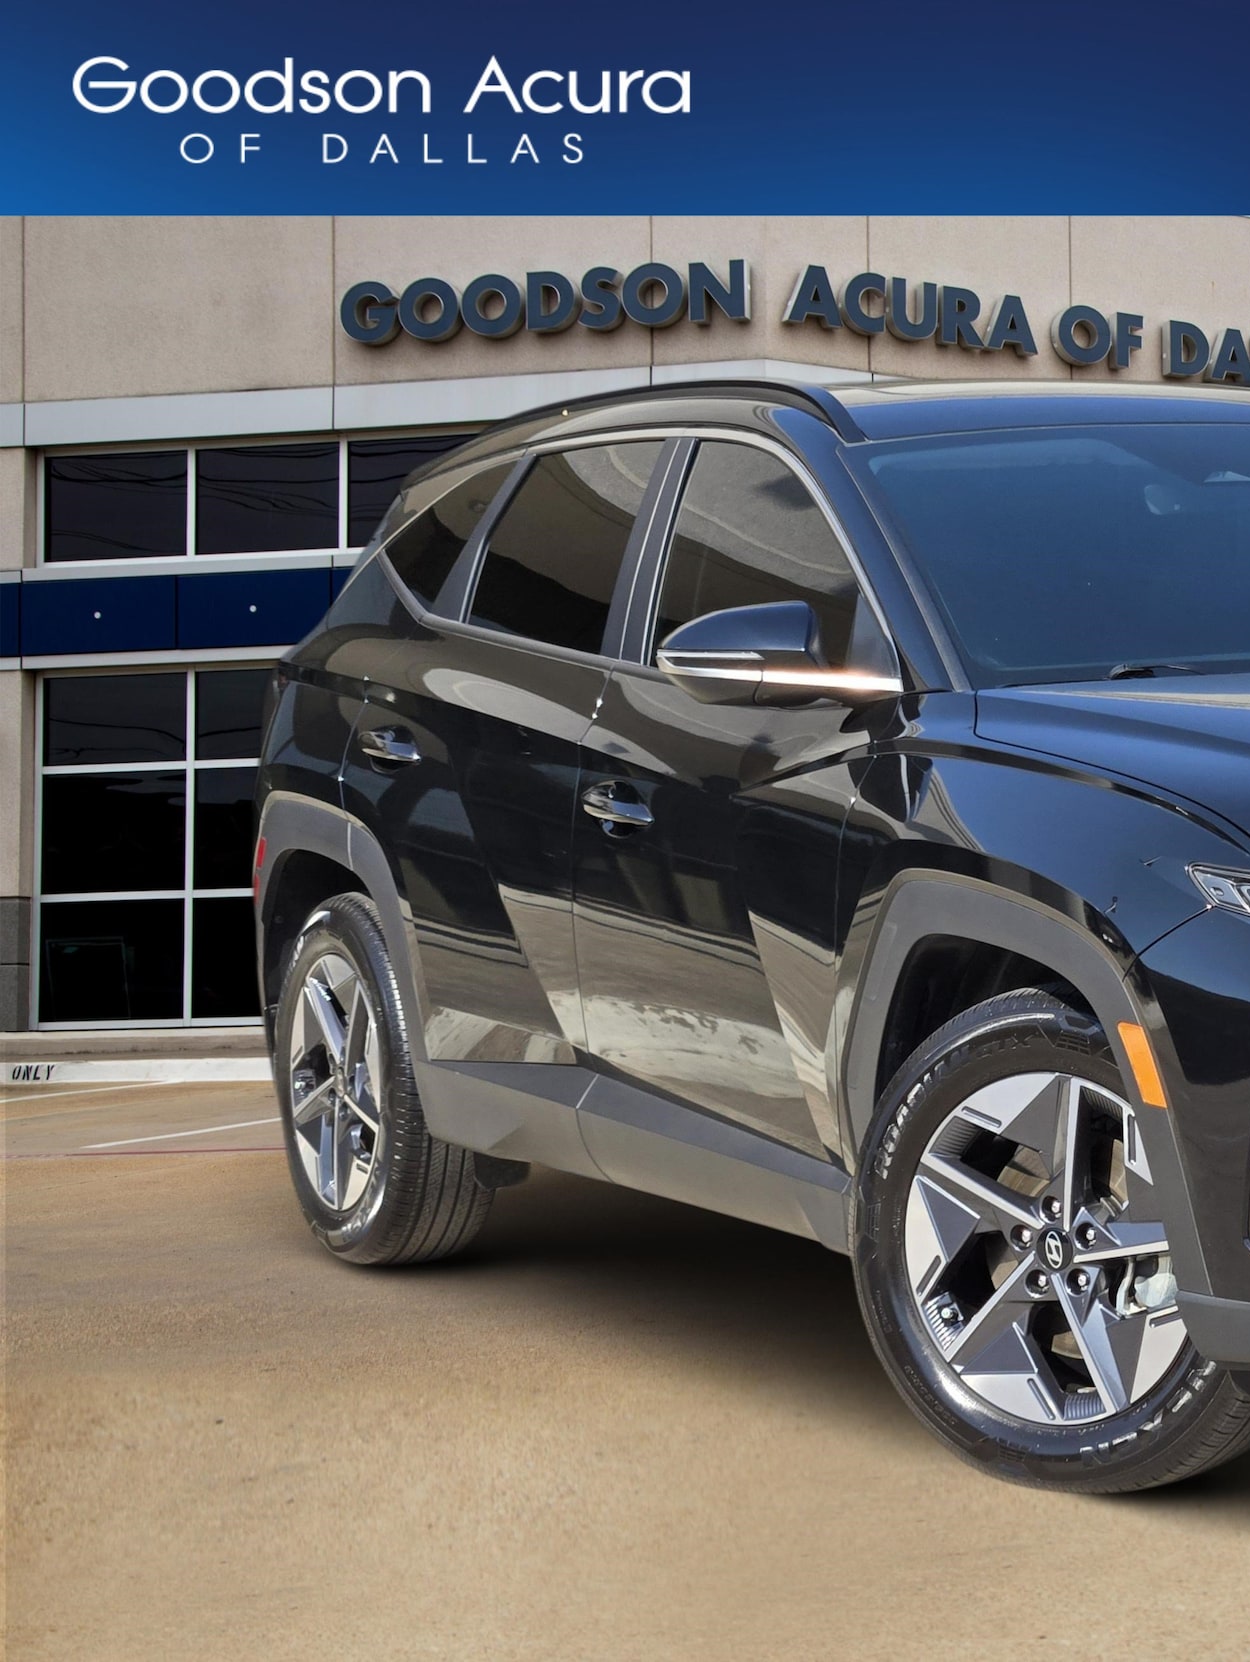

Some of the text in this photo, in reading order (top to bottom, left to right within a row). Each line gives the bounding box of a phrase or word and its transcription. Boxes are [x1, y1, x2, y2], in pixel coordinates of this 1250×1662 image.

[340, 259, 752, 346] GOODSON
[783, 264, 1038, 356] ACURA
[1052, 305, 1144, 369] OF
[11, 1064, 56, 1081] ONLY
